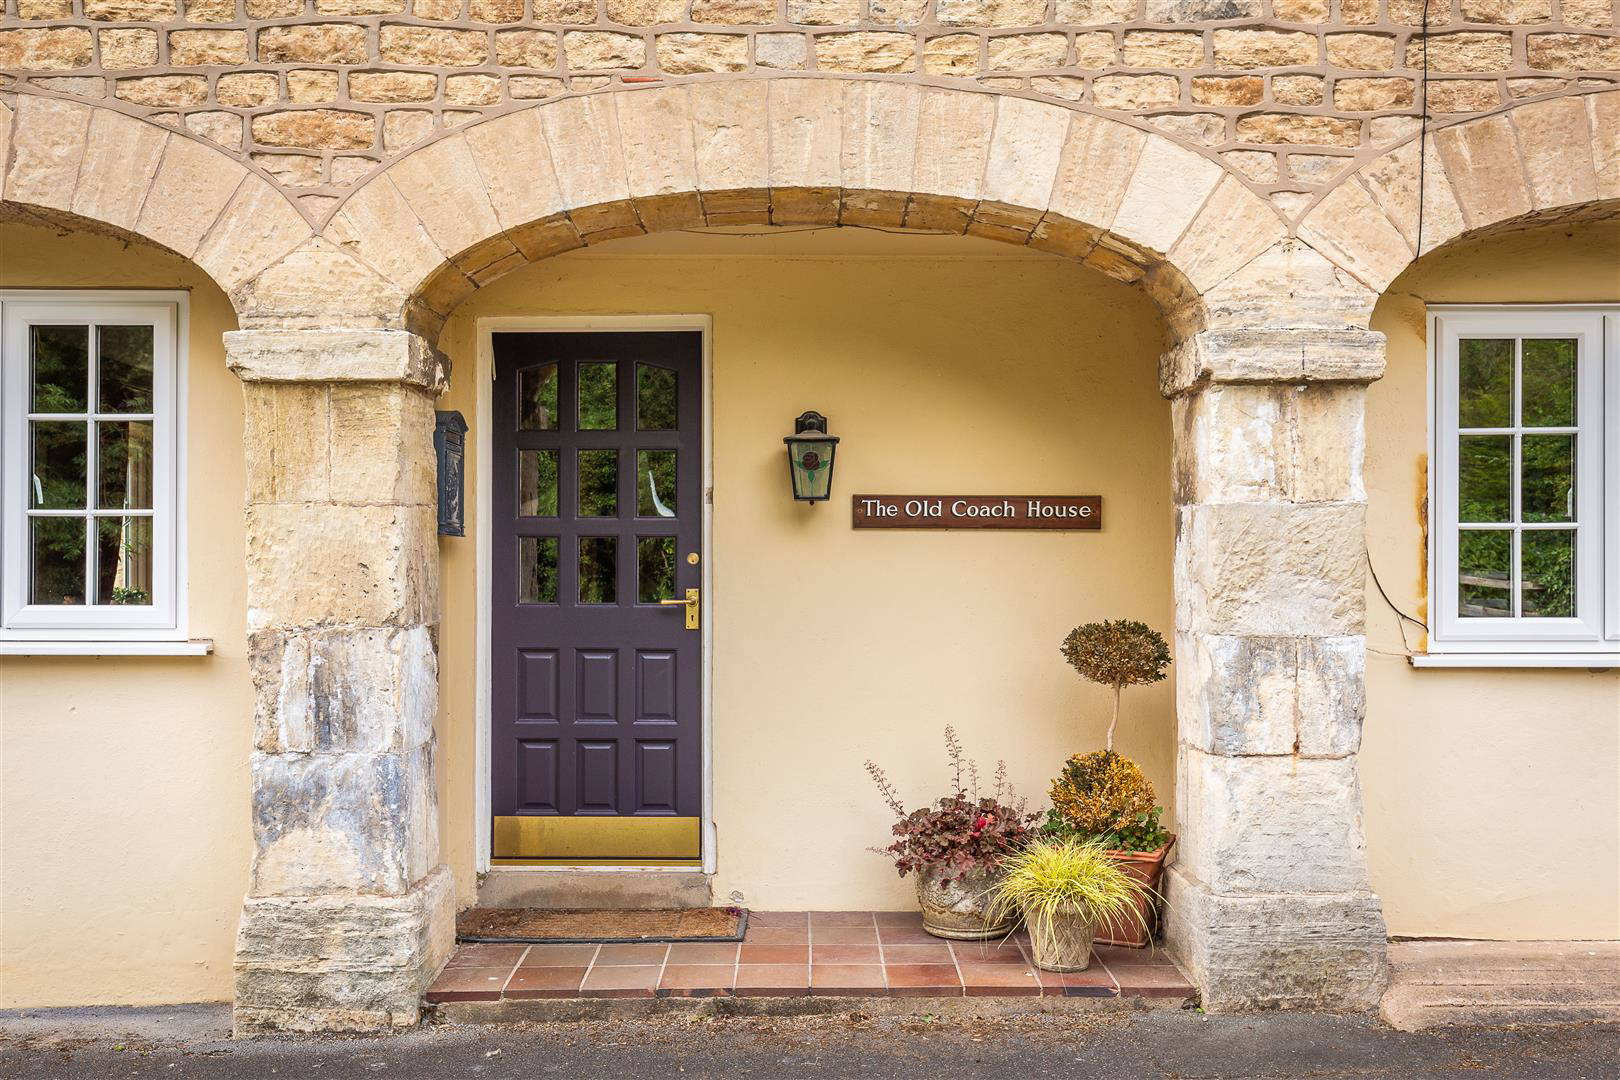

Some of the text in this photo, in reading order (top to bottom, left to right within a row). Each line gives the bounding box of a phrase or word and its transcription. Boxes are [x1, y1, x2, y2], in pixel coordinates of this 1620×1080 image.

[861, 499, 1092, 518] The Old Coach House
